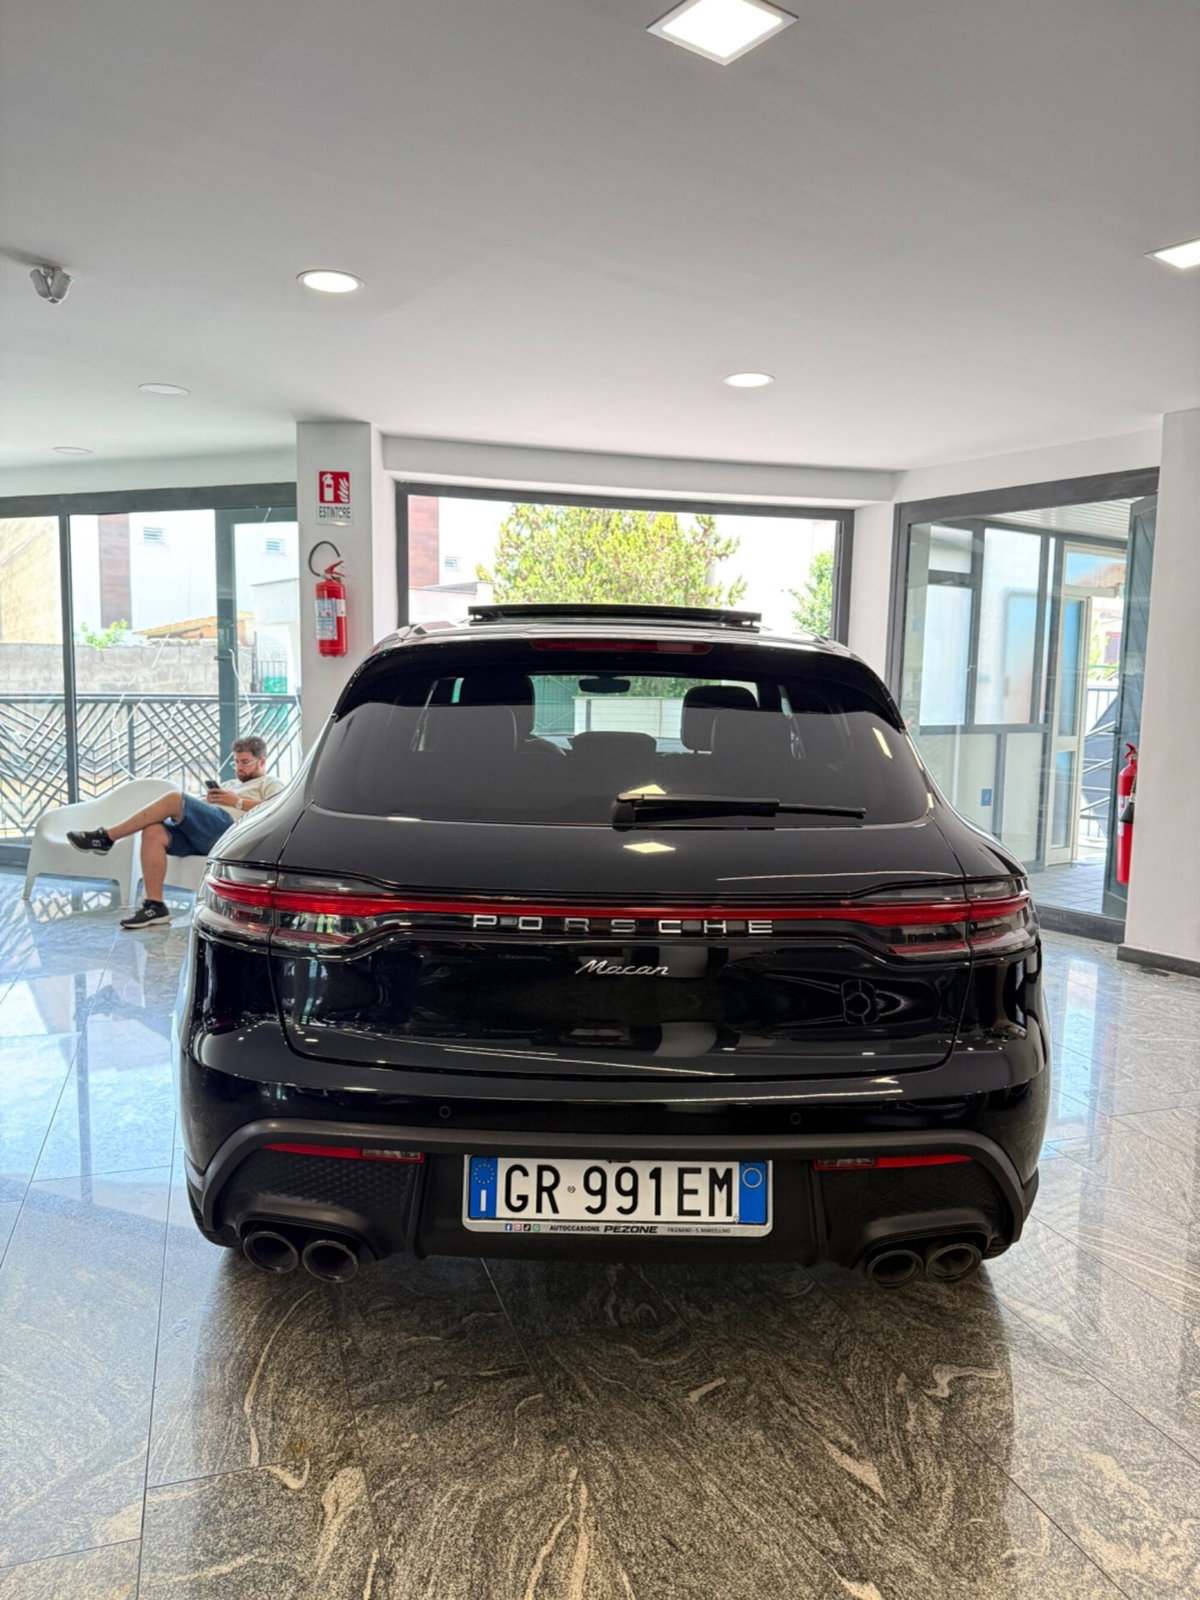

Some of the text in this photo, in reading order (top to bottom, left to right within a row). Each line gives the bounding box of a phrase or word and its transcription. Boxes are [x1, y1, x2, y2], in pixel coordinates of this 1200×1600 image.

[319, 506, 351, 519] ESTINTORE
[472, 914, 774, 934] PORSCHE
[575, 959, 670, 975] Macan
[504, 1164, 561, 1214] GR
[603, 1225, 659, 1234] PEZONE
